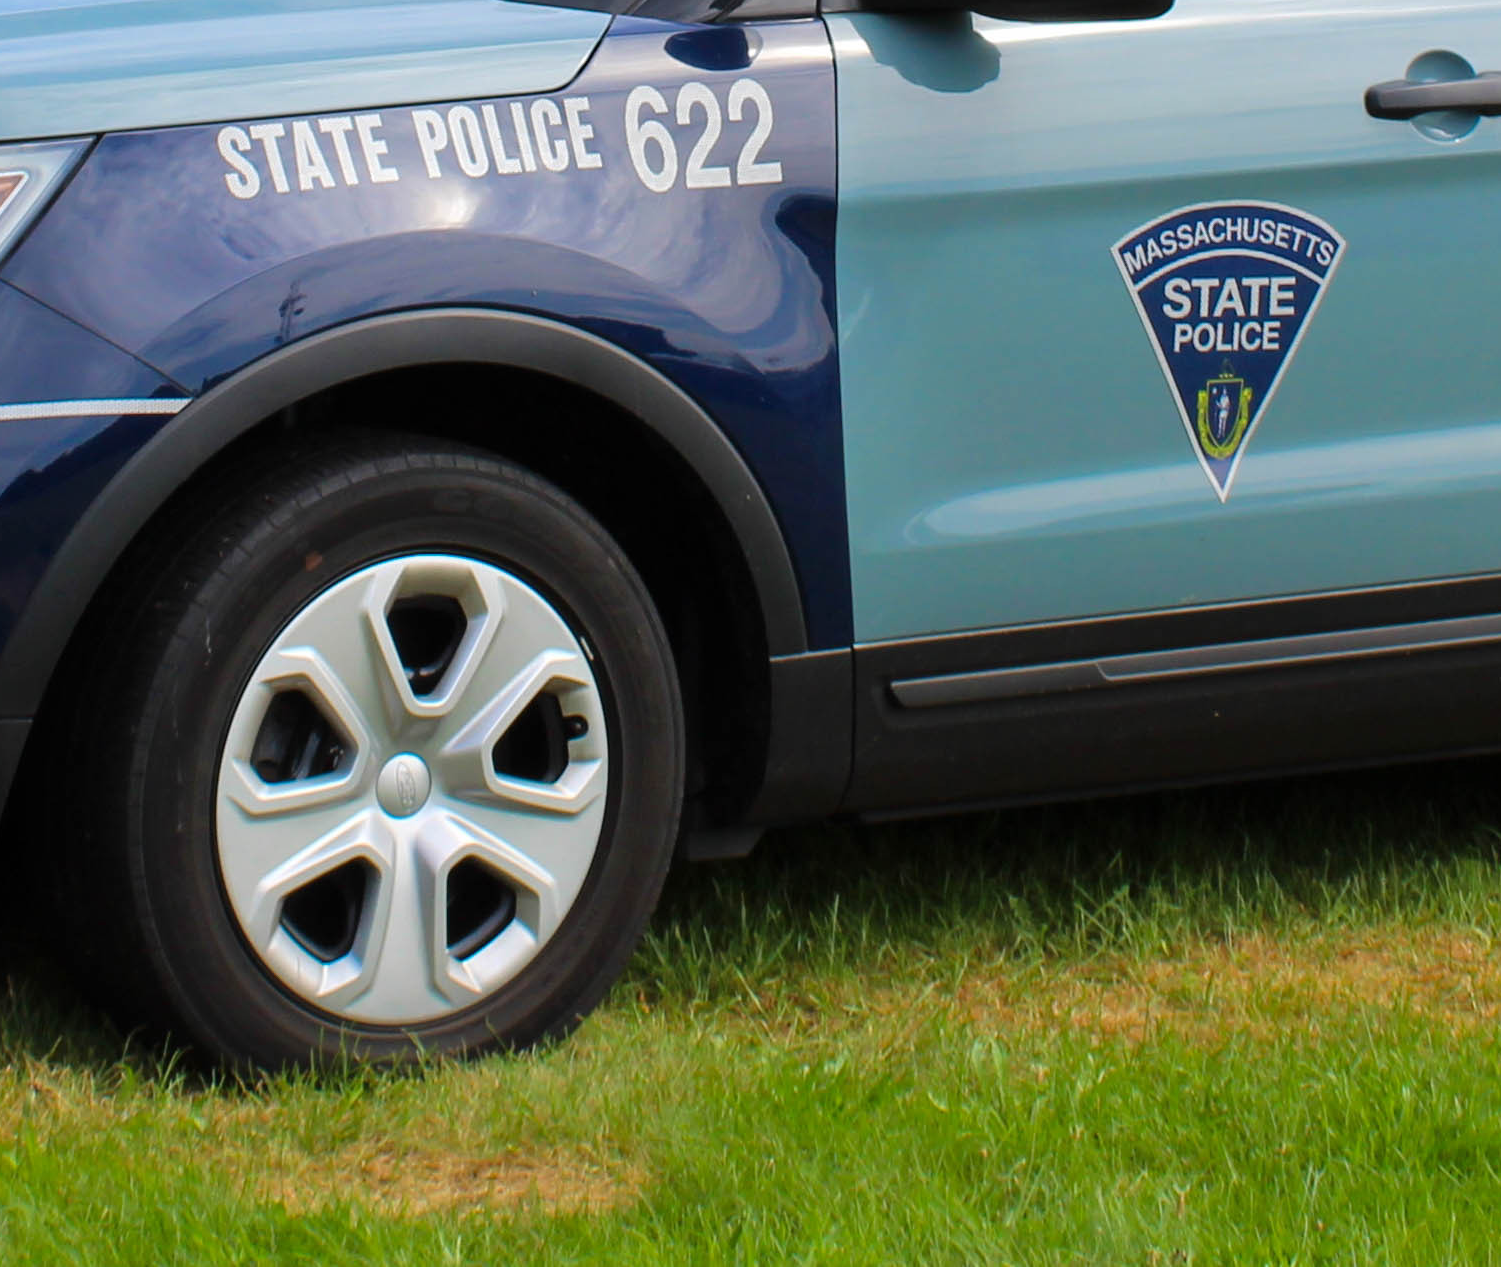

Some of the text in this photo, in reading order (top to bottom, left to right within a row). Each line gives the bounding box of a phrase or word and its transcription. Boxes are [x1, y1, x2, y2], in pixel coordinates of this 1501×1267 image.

[216, 77, 783, 200] STATE POLICE 622
[1122, 217, 1336, 276] MASSACHUSETTS
[1162, 276, 1296, 320] STATE
[1173, 321, 1281, 354] POLICE
